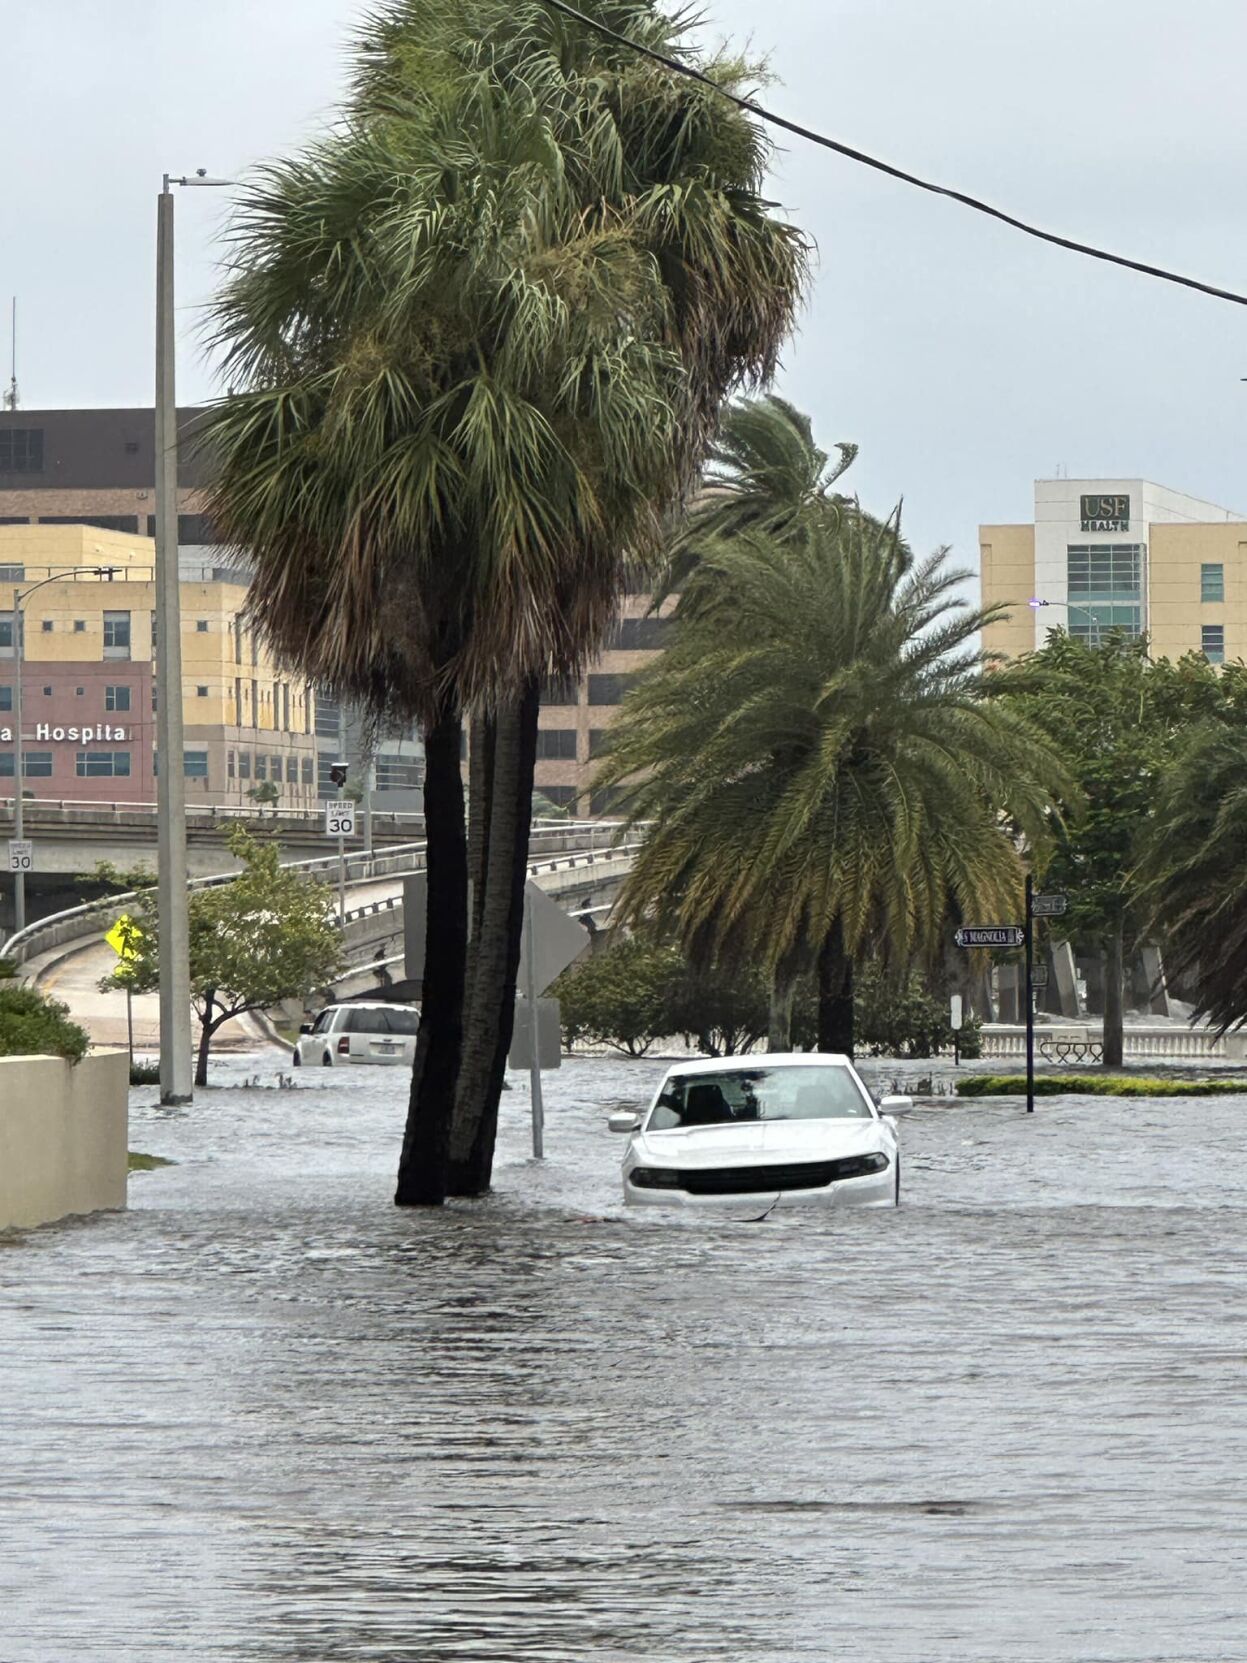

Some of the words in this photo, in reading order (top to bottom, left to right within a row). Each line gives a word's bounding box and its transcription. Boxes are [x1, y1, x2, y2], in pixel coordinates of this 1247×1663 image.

[1085, 497, 1127, 518] USF
[1081, 520, 1129, 532] HEALTH
[329, 819, 352, 832] 30
[11, 856, 30, 869] 30
